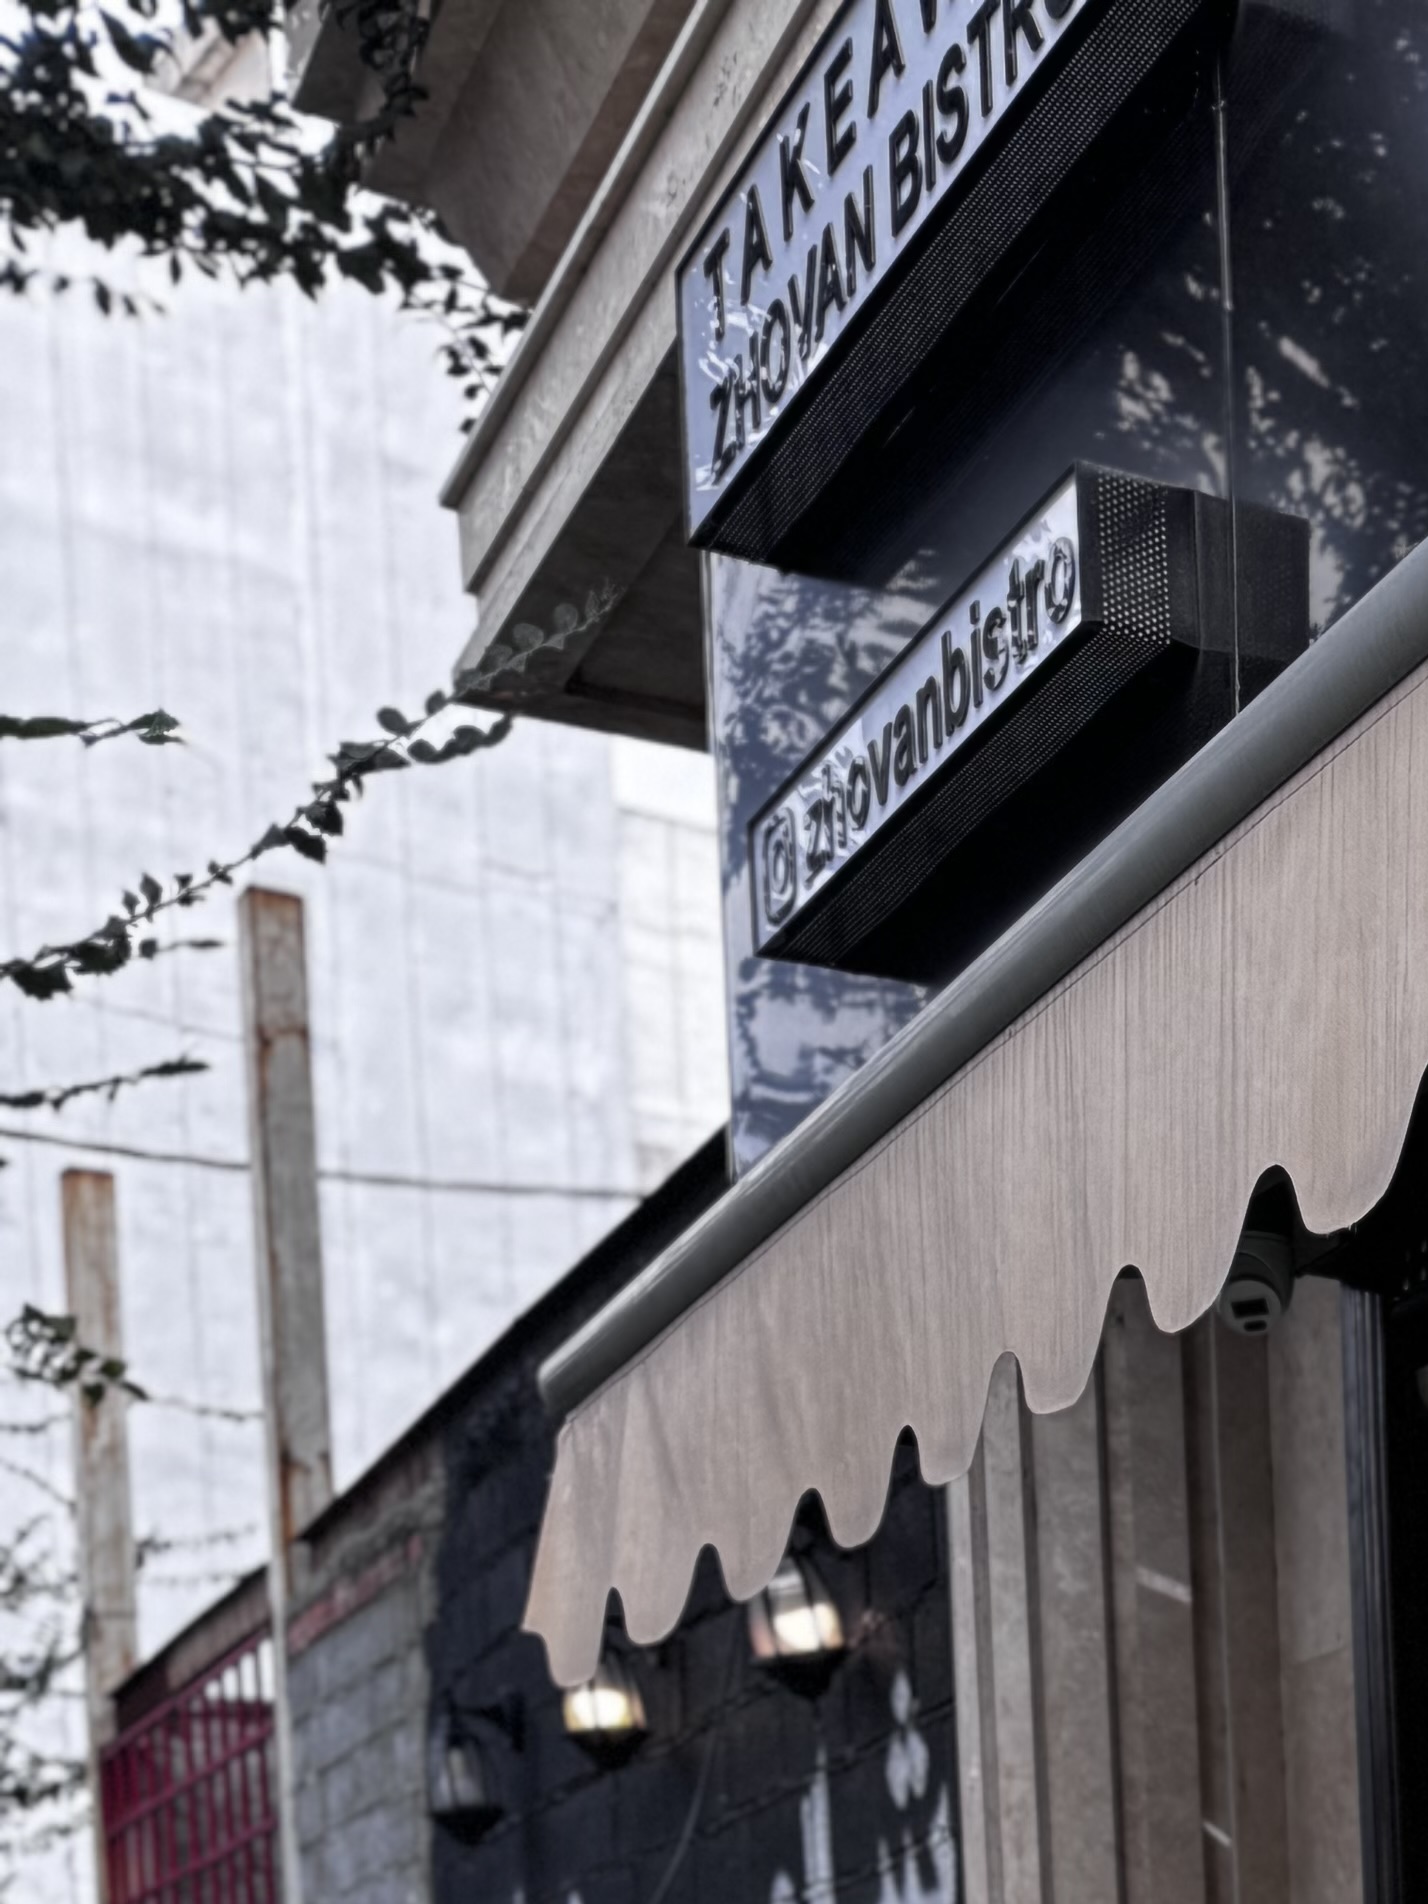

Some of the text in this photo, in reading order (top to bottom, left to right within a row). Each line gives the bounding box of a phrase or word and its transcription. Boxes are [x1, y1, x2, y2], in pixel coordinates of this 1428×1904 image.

[704, 0, 940, 341] TAKEA
[710, 0, 1078, 486] ZHOVAN BISTR
[805, 537, 1076, 890] zhovanbistro
